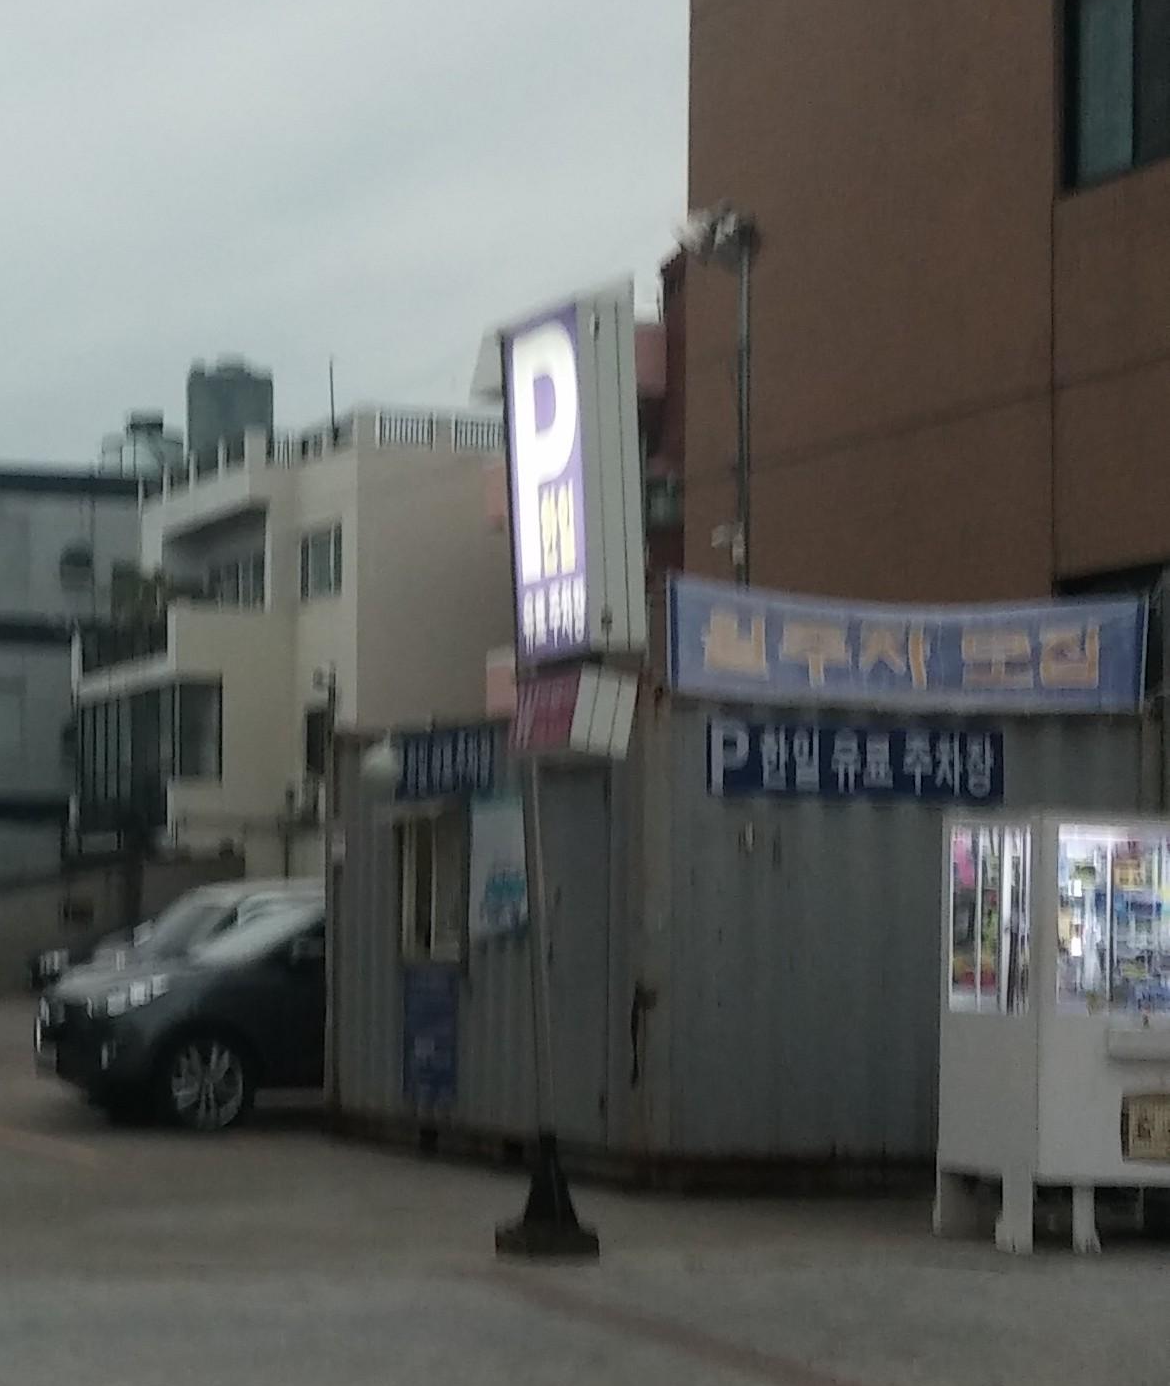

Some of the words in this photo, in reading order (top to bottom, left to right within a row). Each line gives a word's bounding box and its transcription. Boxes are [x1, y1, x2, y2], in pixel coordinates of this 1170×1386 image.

[512, 320, 578, 585] P
[711, 719, 749, 795] P
[832, 727, 893, 794] 유료
[903, 729, 994, 799] 주차장
